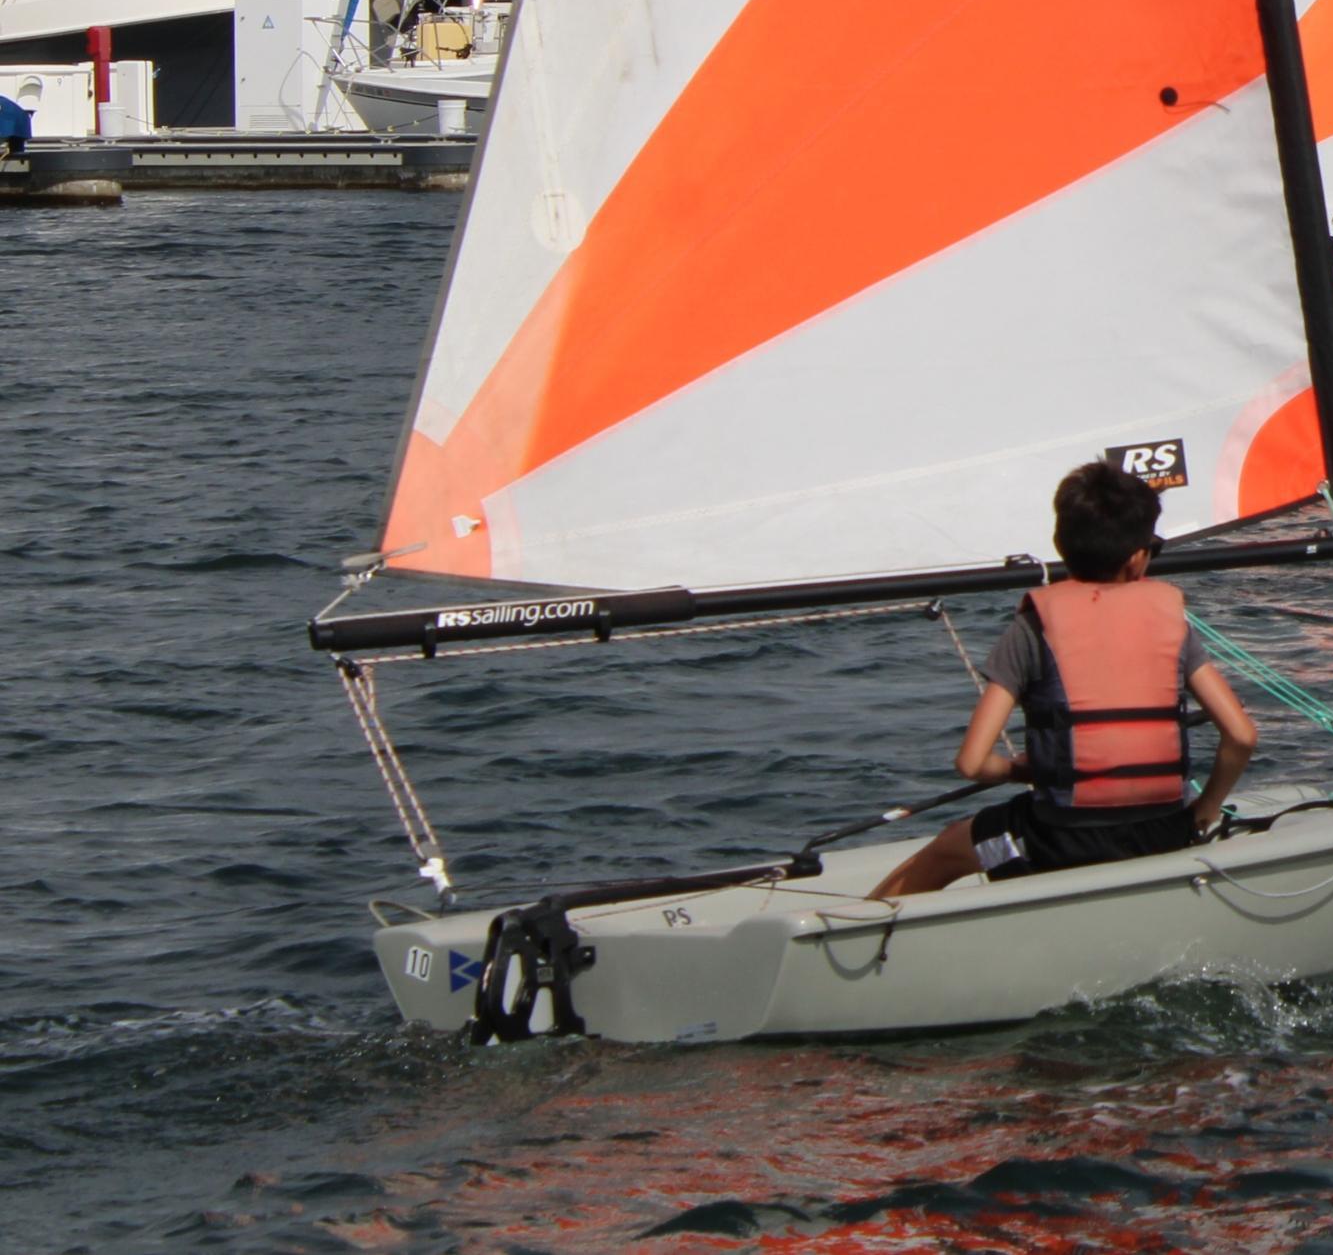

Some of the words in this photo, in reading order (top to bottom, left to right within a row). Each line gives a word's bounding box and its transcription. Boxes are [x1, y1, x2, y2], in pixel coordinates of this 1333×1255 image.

[1122, 444, 1178, 474] RS
[437, 601, 594, 628] RSsailing.com
[411, 949, 430, 978] 10
